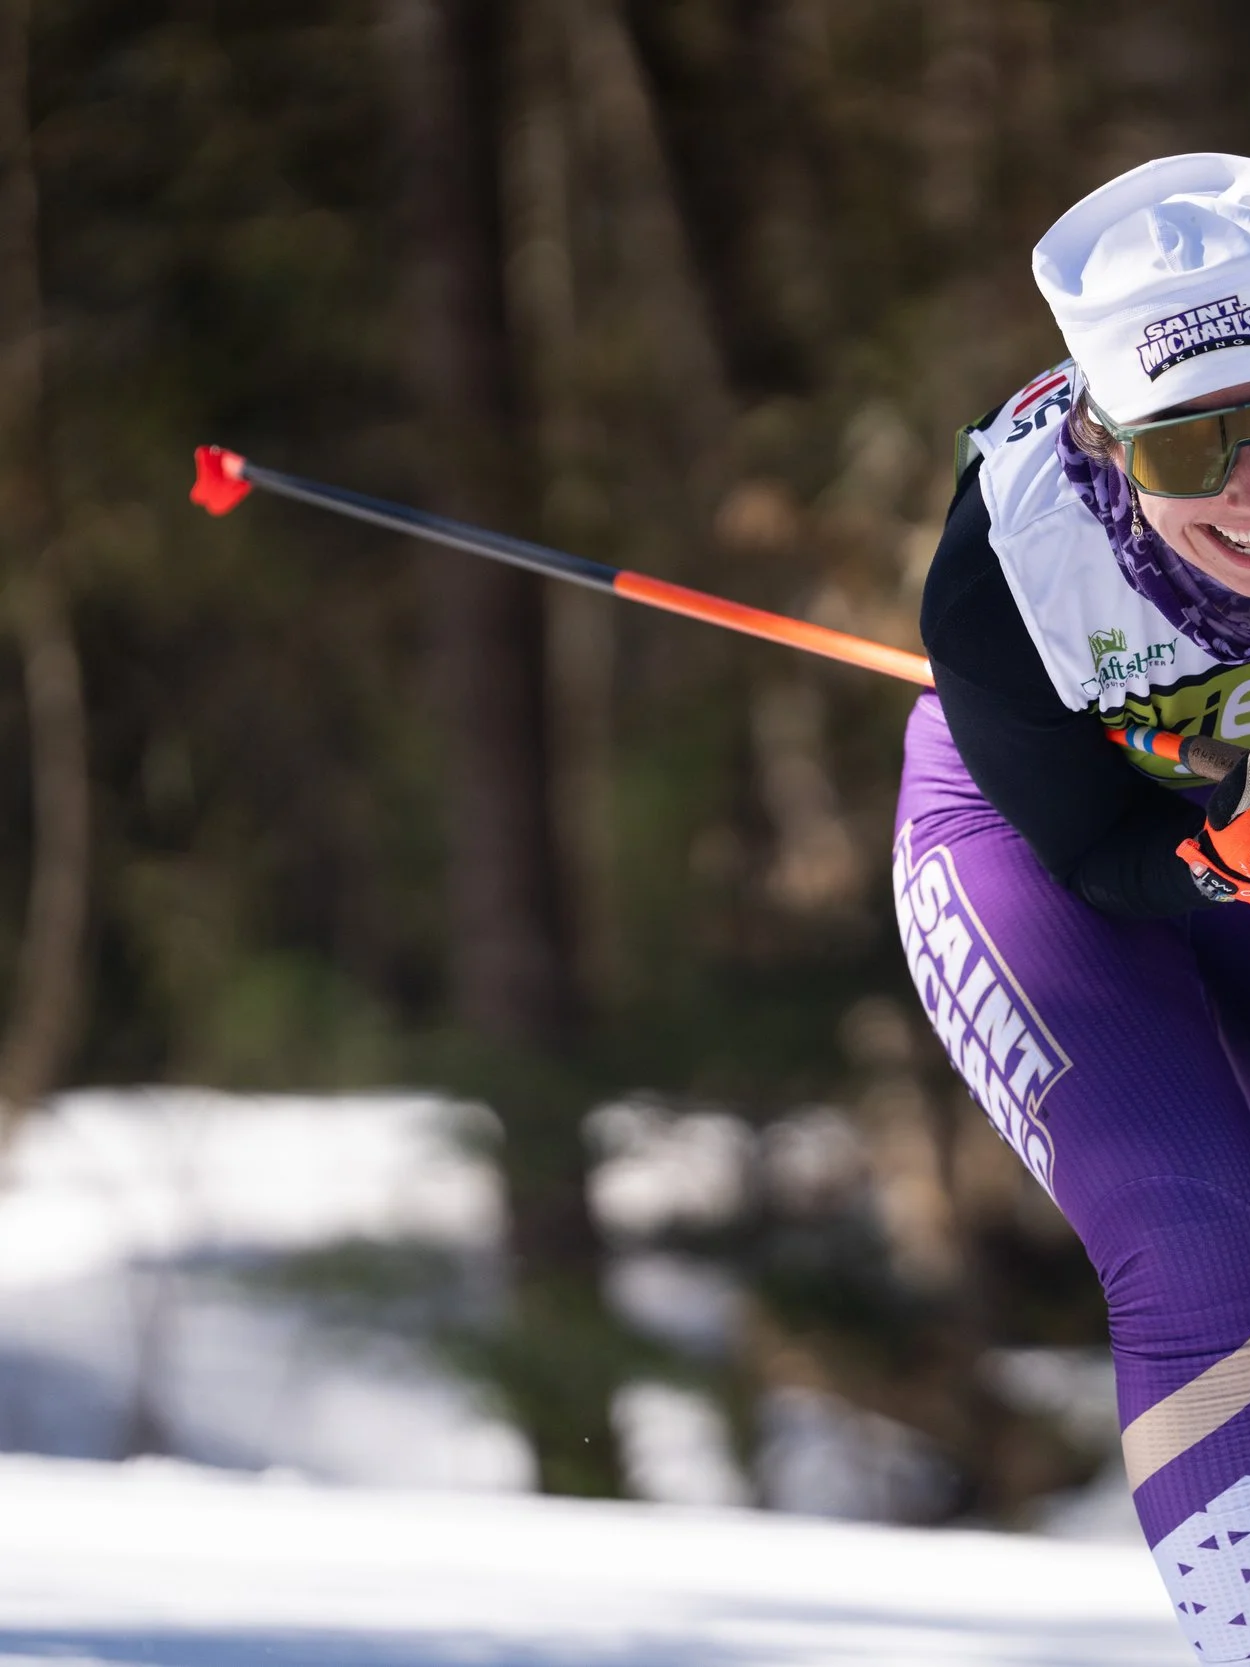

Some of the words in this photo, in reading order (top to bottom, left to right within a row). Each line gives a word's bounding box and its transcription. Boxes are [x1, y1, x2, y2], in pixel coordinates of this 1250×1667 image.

[1144, 298, 1240, 341] SAINT
[1161, 338, 1245, 371] SKIING
[911, 858, 1055, 1105] SAINT
